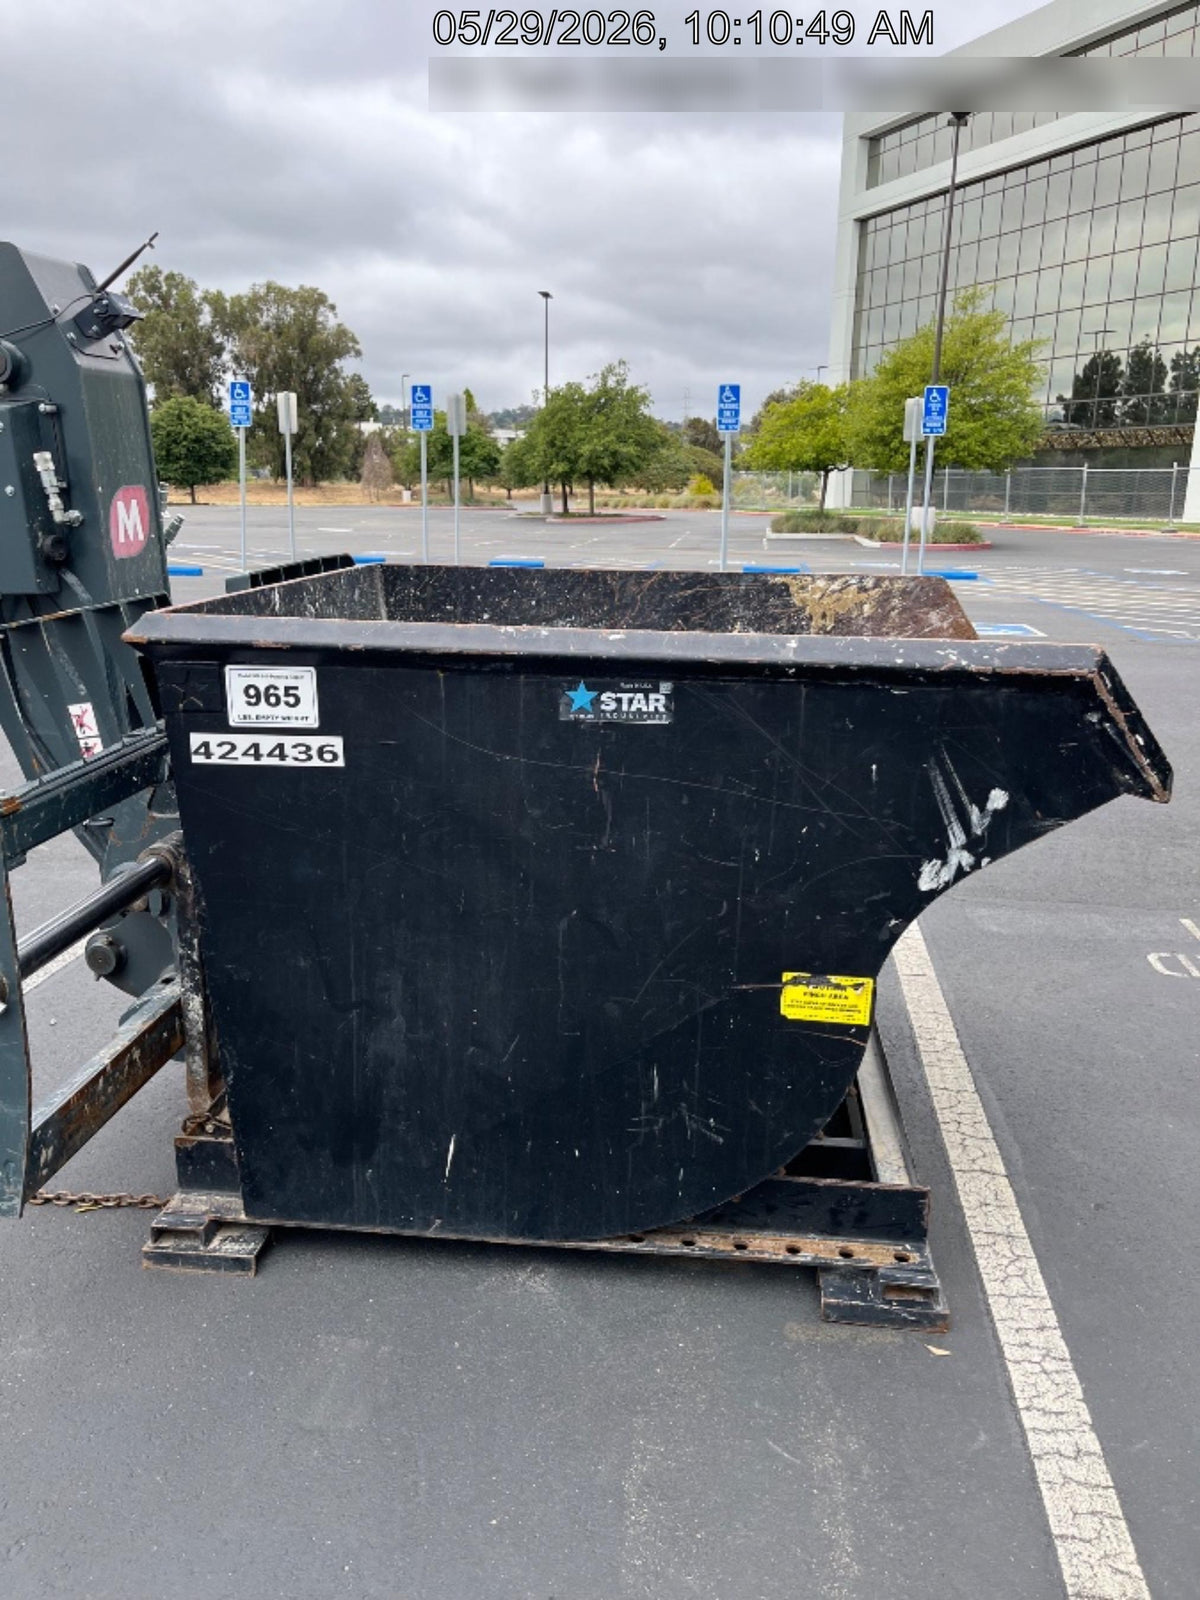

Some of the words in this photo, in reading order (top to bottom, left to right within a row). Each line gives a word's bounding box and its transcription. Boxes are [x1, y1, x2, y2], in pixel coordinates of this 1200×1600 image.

[116, 499, 144, 543] M
[243, 684, 301, 708] 965
[600, 691, 666, 712] STAR
[192, 741, 339, 763] 424436
